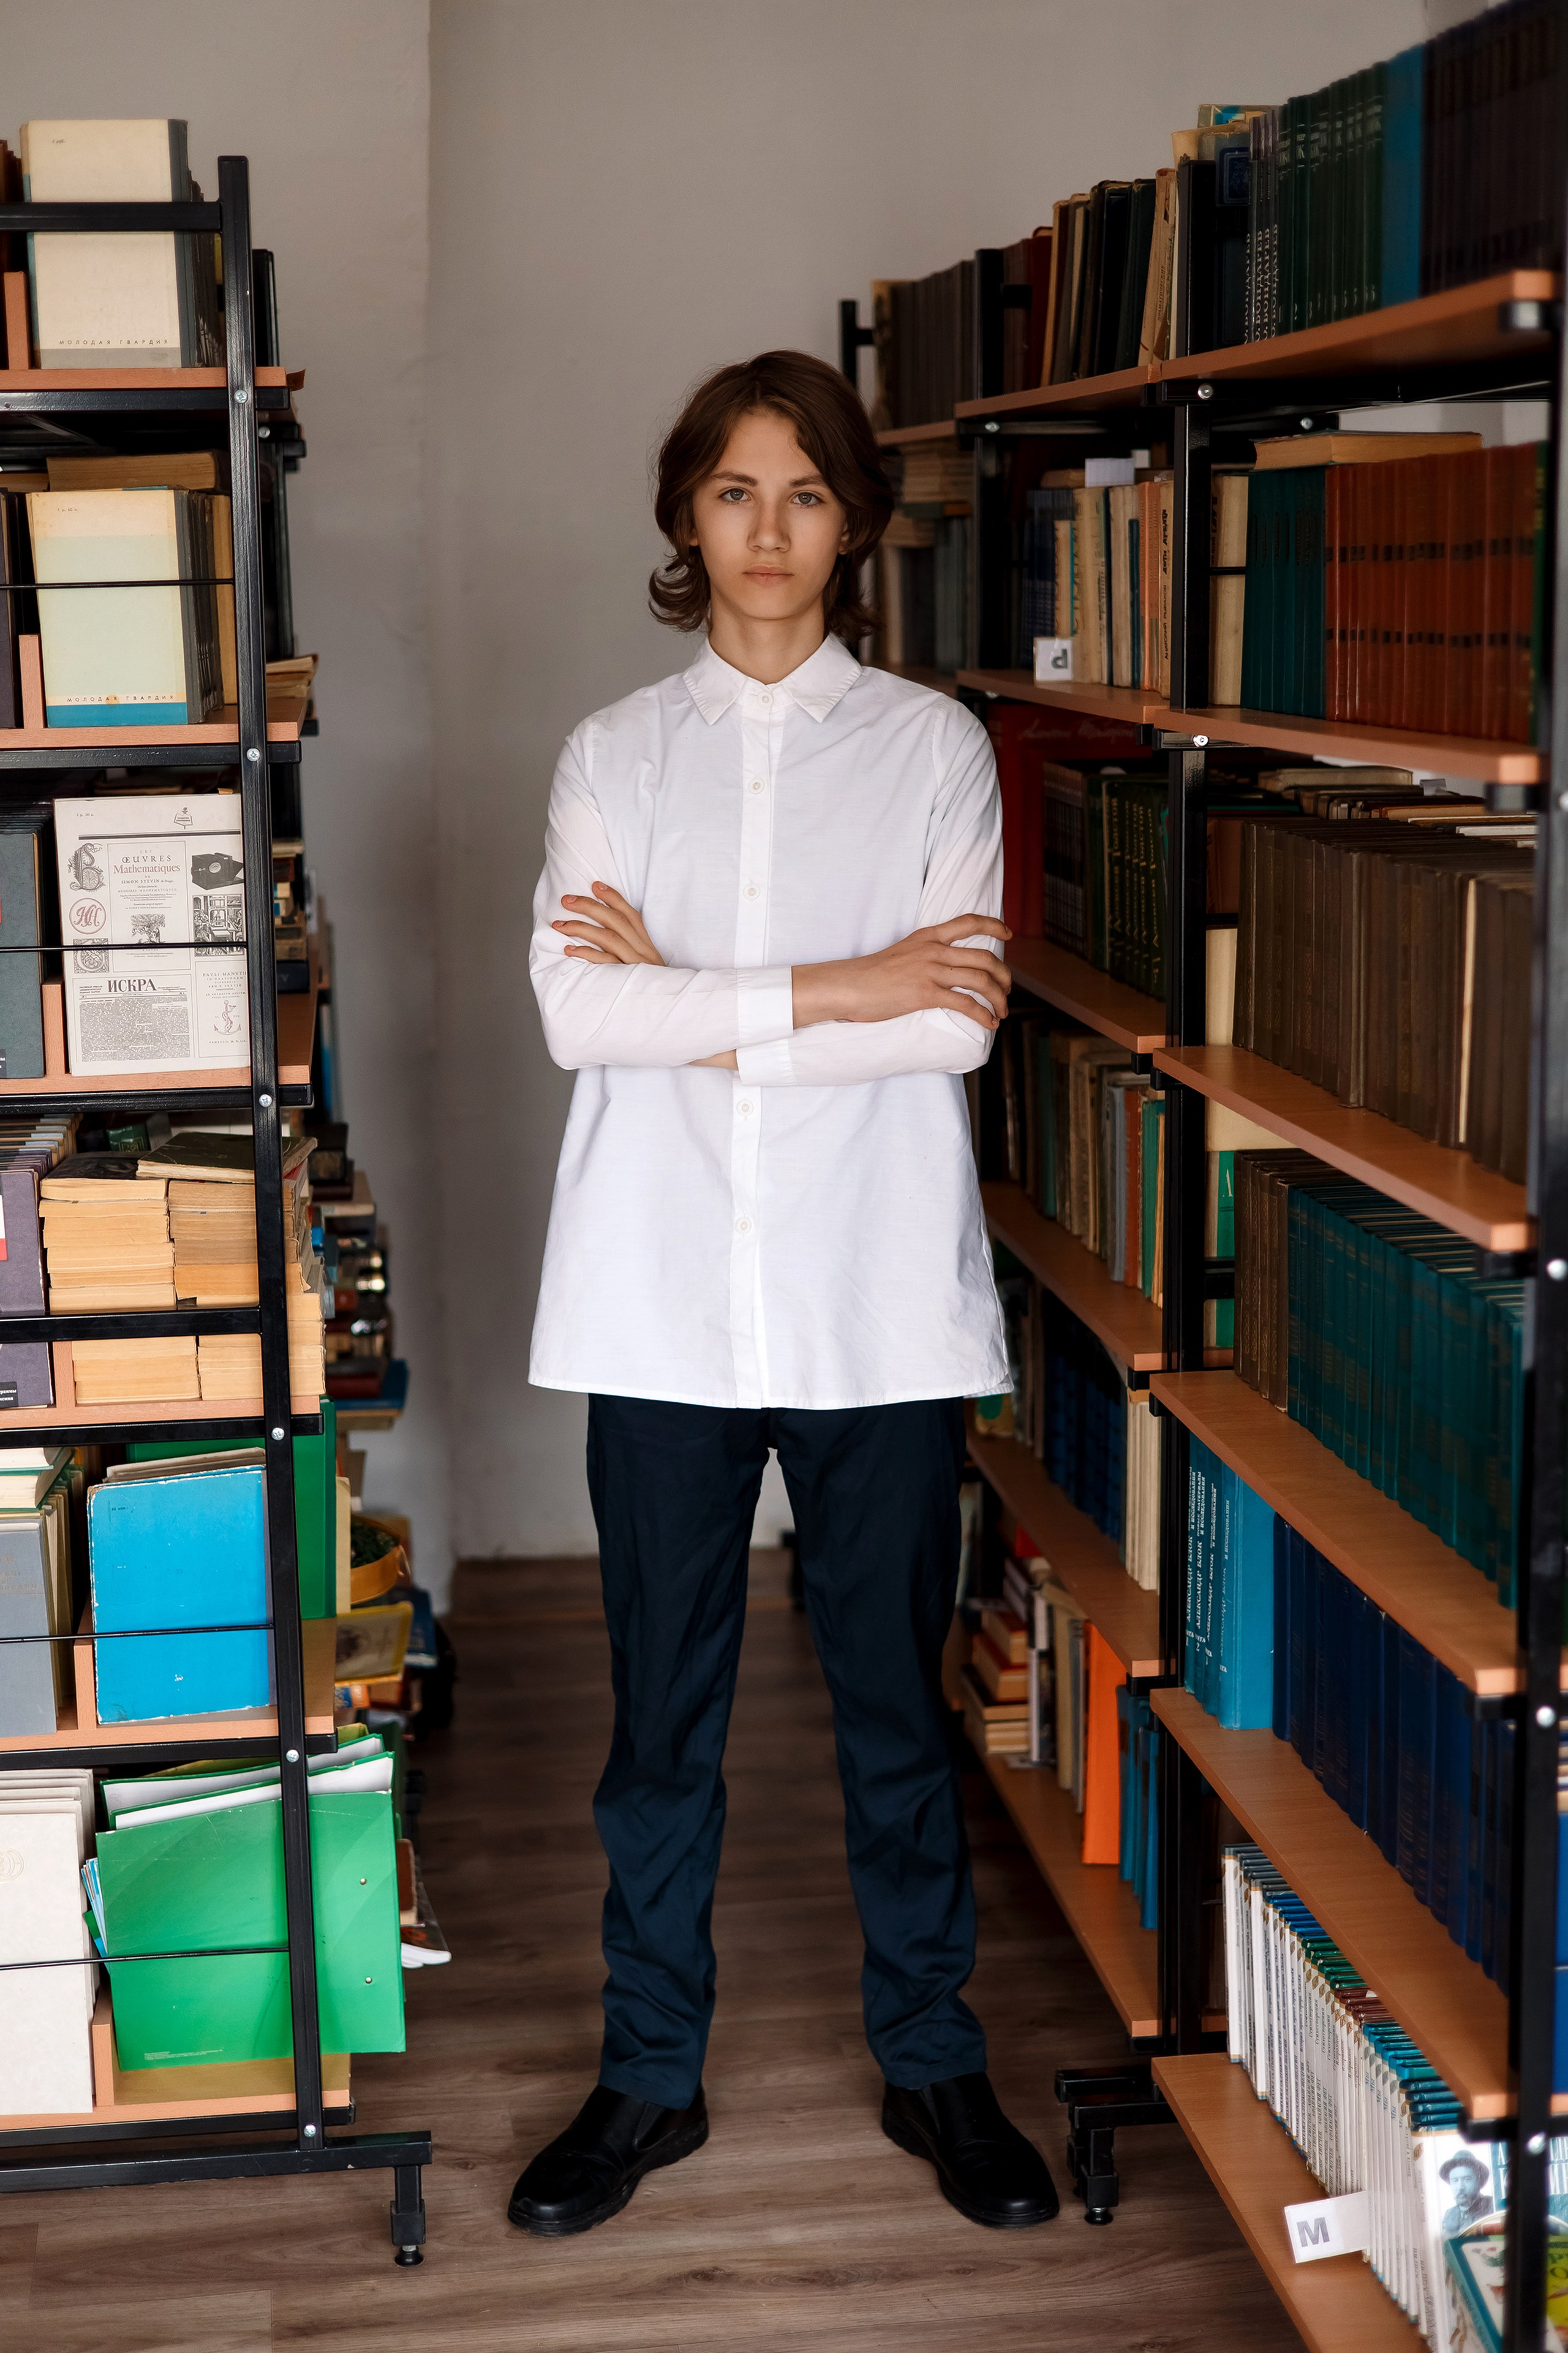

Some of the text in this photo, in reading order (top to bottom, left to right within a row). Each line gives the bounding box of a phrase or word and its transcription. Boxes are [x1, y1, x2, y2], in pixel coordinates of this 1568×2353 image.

[113, 863, 181, 874] Mathematiques
[107, 978, 157, 992] ИСКРА
[1196, 1642, 1200, 1652] 2
[1365, 2070, 1370, 2085] Мы
[1370, 2077, 1375, 2093] Мы
[1376, 2088, 1381, 2104] Мы
[1382, 2096, 1388, 2111] Мы
[1390, 2105, 1396, 2121] Мы
